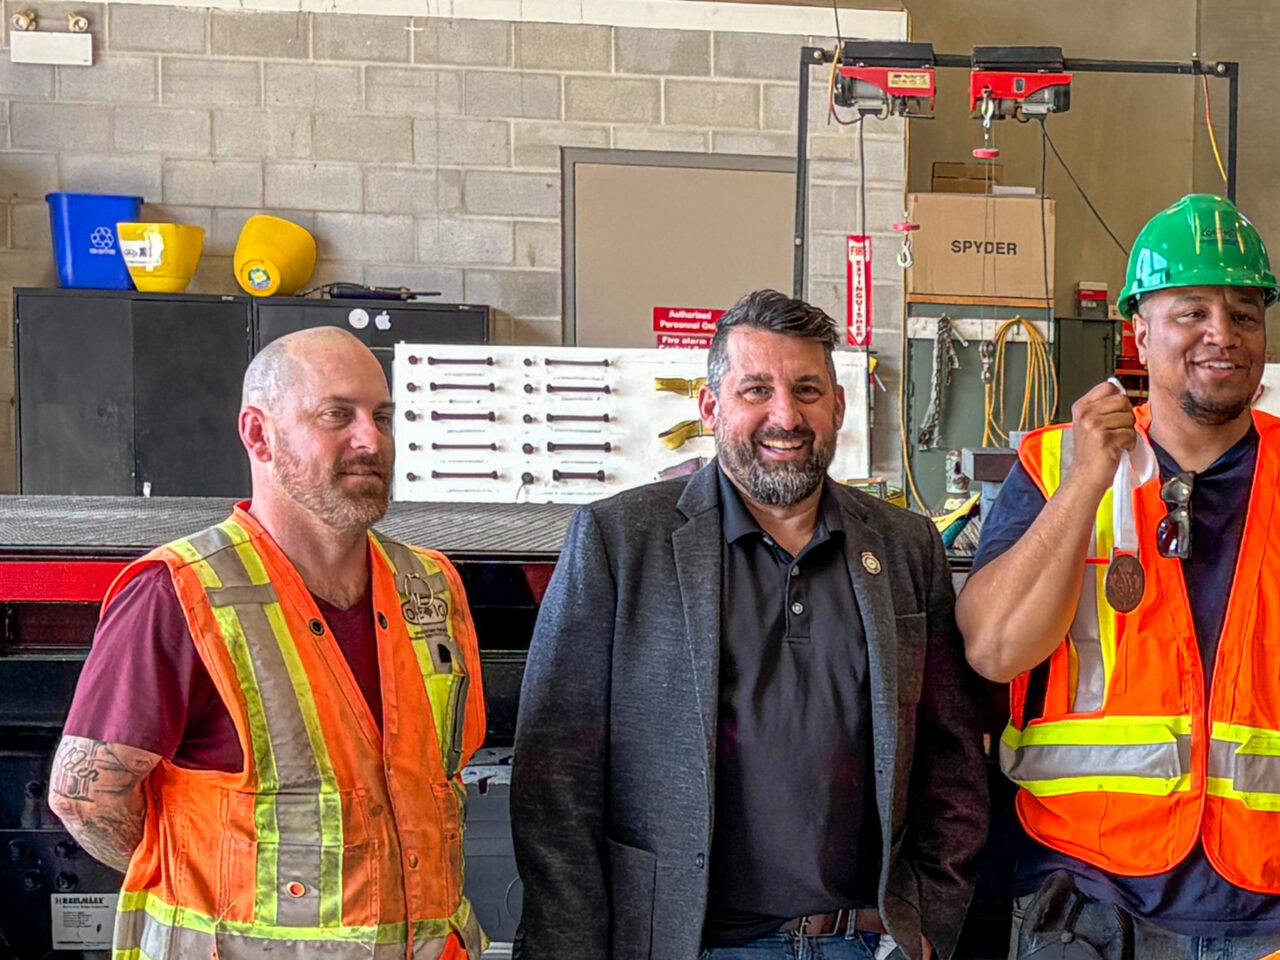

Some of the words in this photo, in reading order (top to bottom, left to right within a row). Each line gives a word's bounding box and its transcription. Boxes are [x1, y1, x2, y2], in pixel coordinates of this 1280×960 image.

[951, 240, 1017, 255] SPYDER
[669, 310, 712, 320] Authorized
[660, 320, 700, 329] Personnel
[662, 336, 680, 344] Fire
